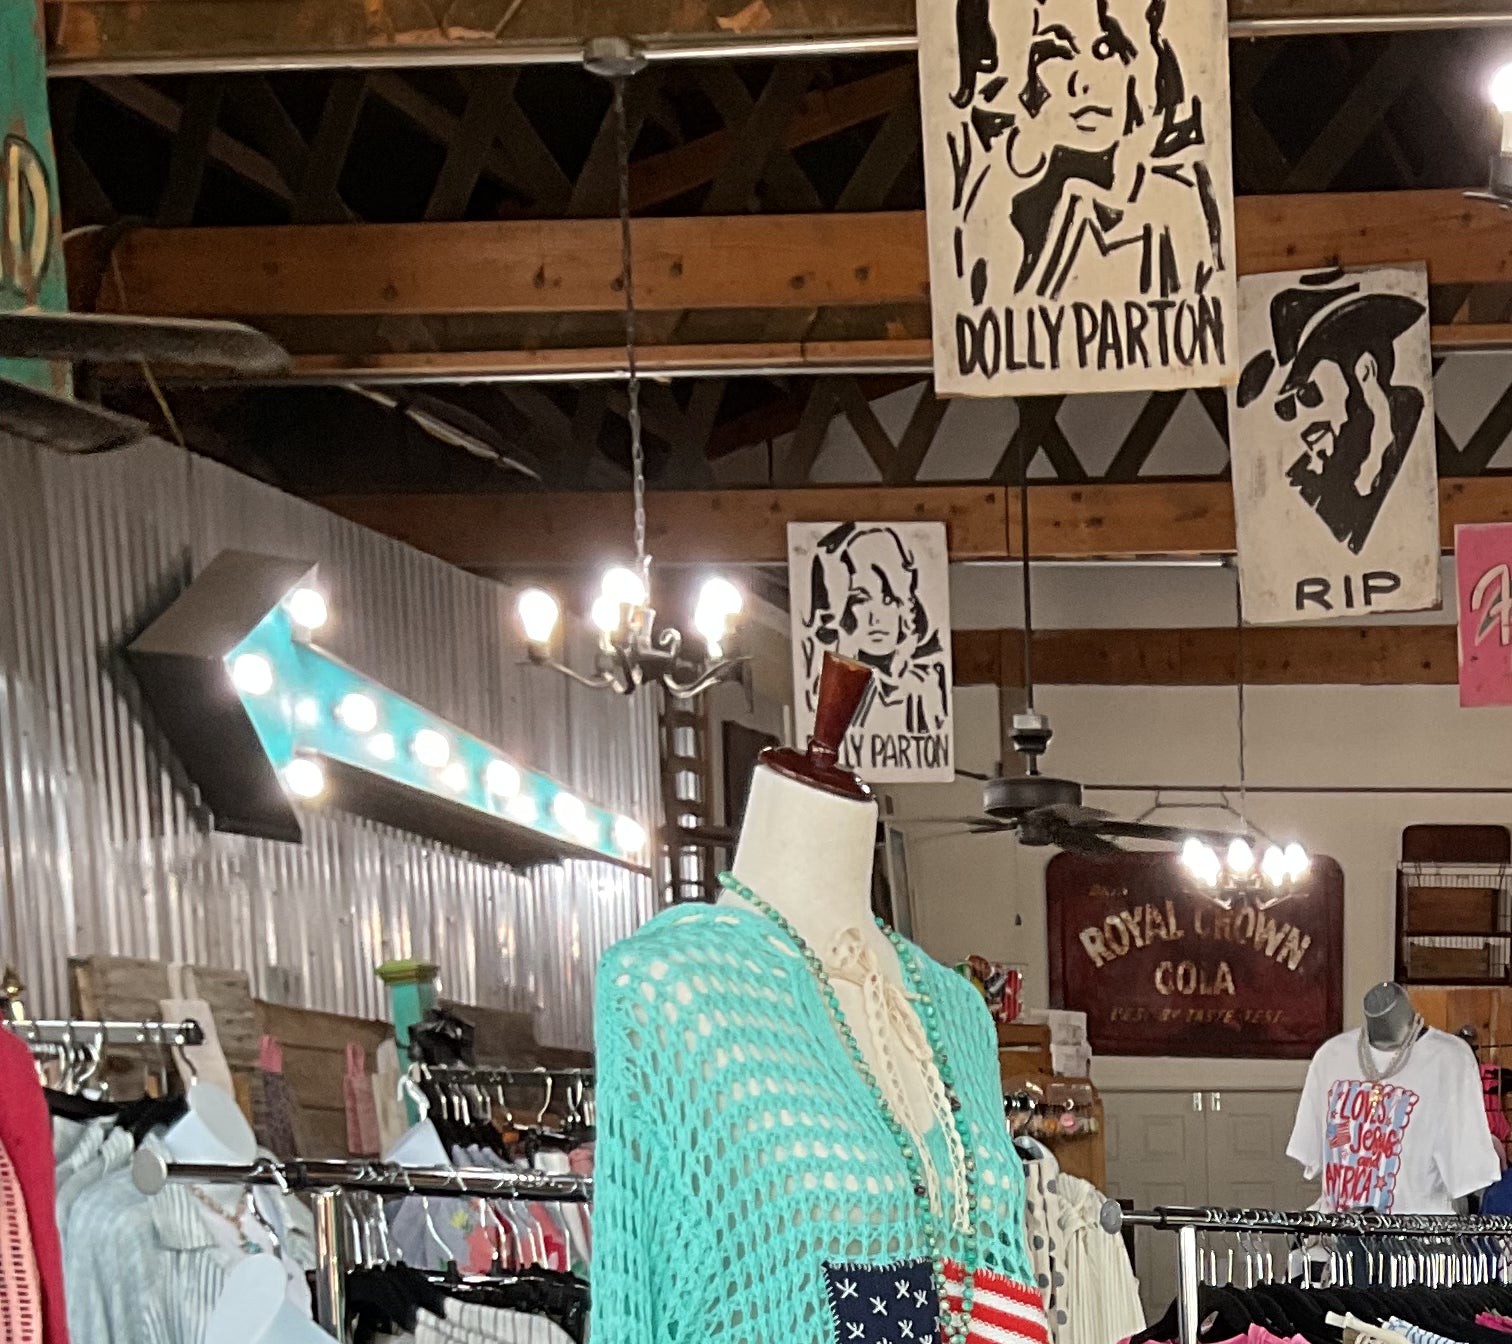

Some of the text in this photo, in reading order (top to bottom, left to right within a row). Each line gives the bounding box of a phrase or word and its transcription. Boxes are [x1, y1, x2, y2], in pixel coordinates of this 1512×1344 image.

[956, 294, 1226, 380] DOLLY PARTON
[1296, 571, 1401, 611] RIP
[870, 733, 949, 769] PARTON
[1079, 900, 1312, 971] ROYAL CROWN
[1154, 960, 1236, 996] COLA
